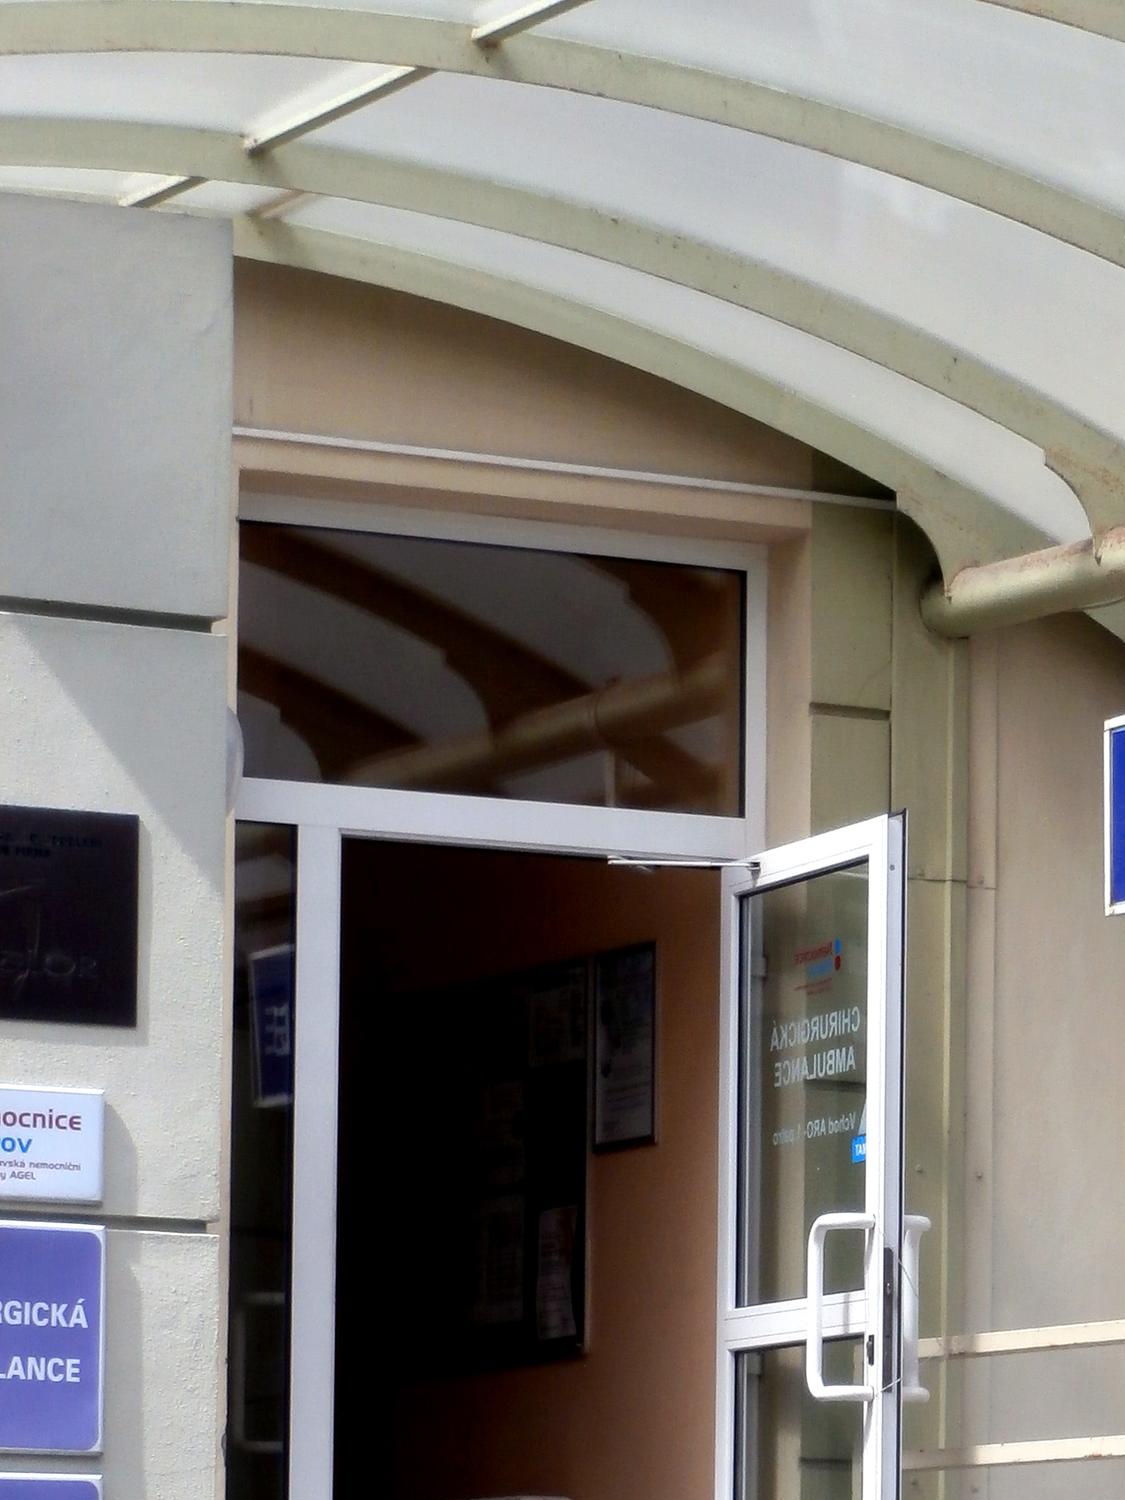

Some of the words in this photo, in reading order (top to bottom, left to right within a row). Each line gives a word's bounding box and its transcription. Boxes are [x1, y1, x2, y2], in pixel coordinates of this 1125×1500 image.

[0, 1109, 82, 1131] ocnice
[9, 1170, 36, 1181] AGEL
[0, 1298, 89, 1329] GICKÁ
